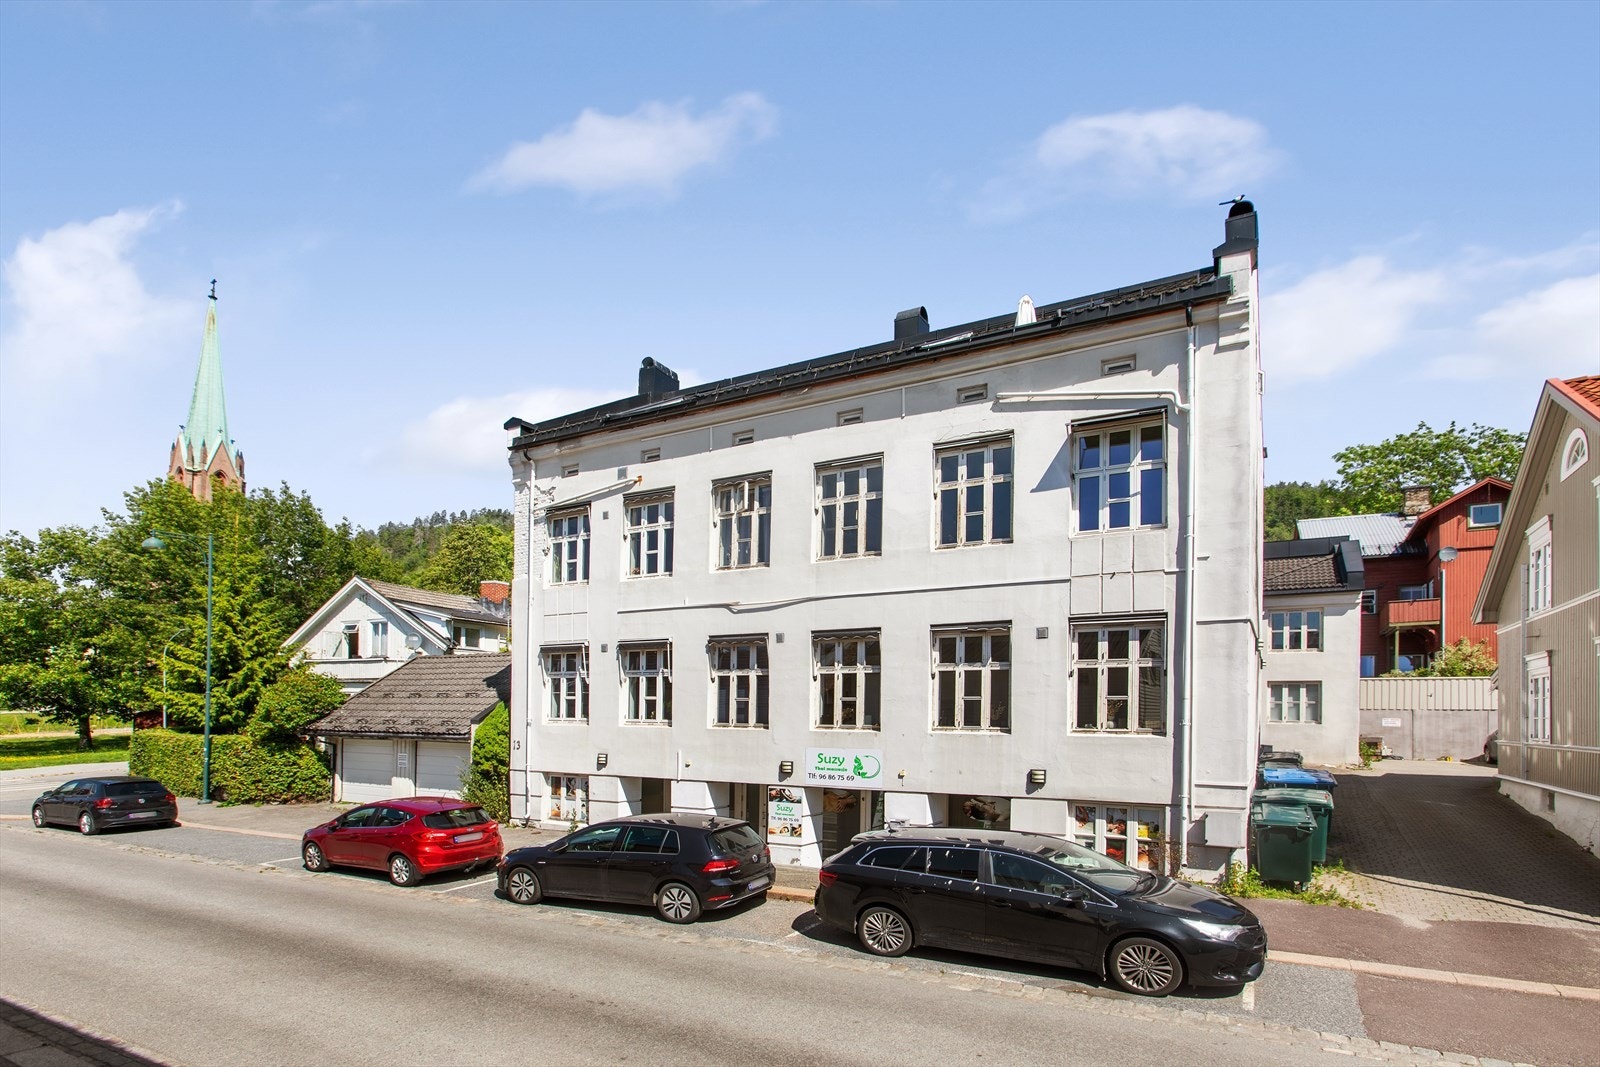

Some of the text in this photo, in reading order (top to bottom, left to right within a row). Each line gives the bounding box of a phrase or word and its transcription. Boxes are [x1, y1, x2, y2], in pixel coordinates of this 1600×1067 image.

[513, 740, 521, 751] 13
[817, 752, 845, 766] Suzy
[776, 804, 793, 813] Suzy
